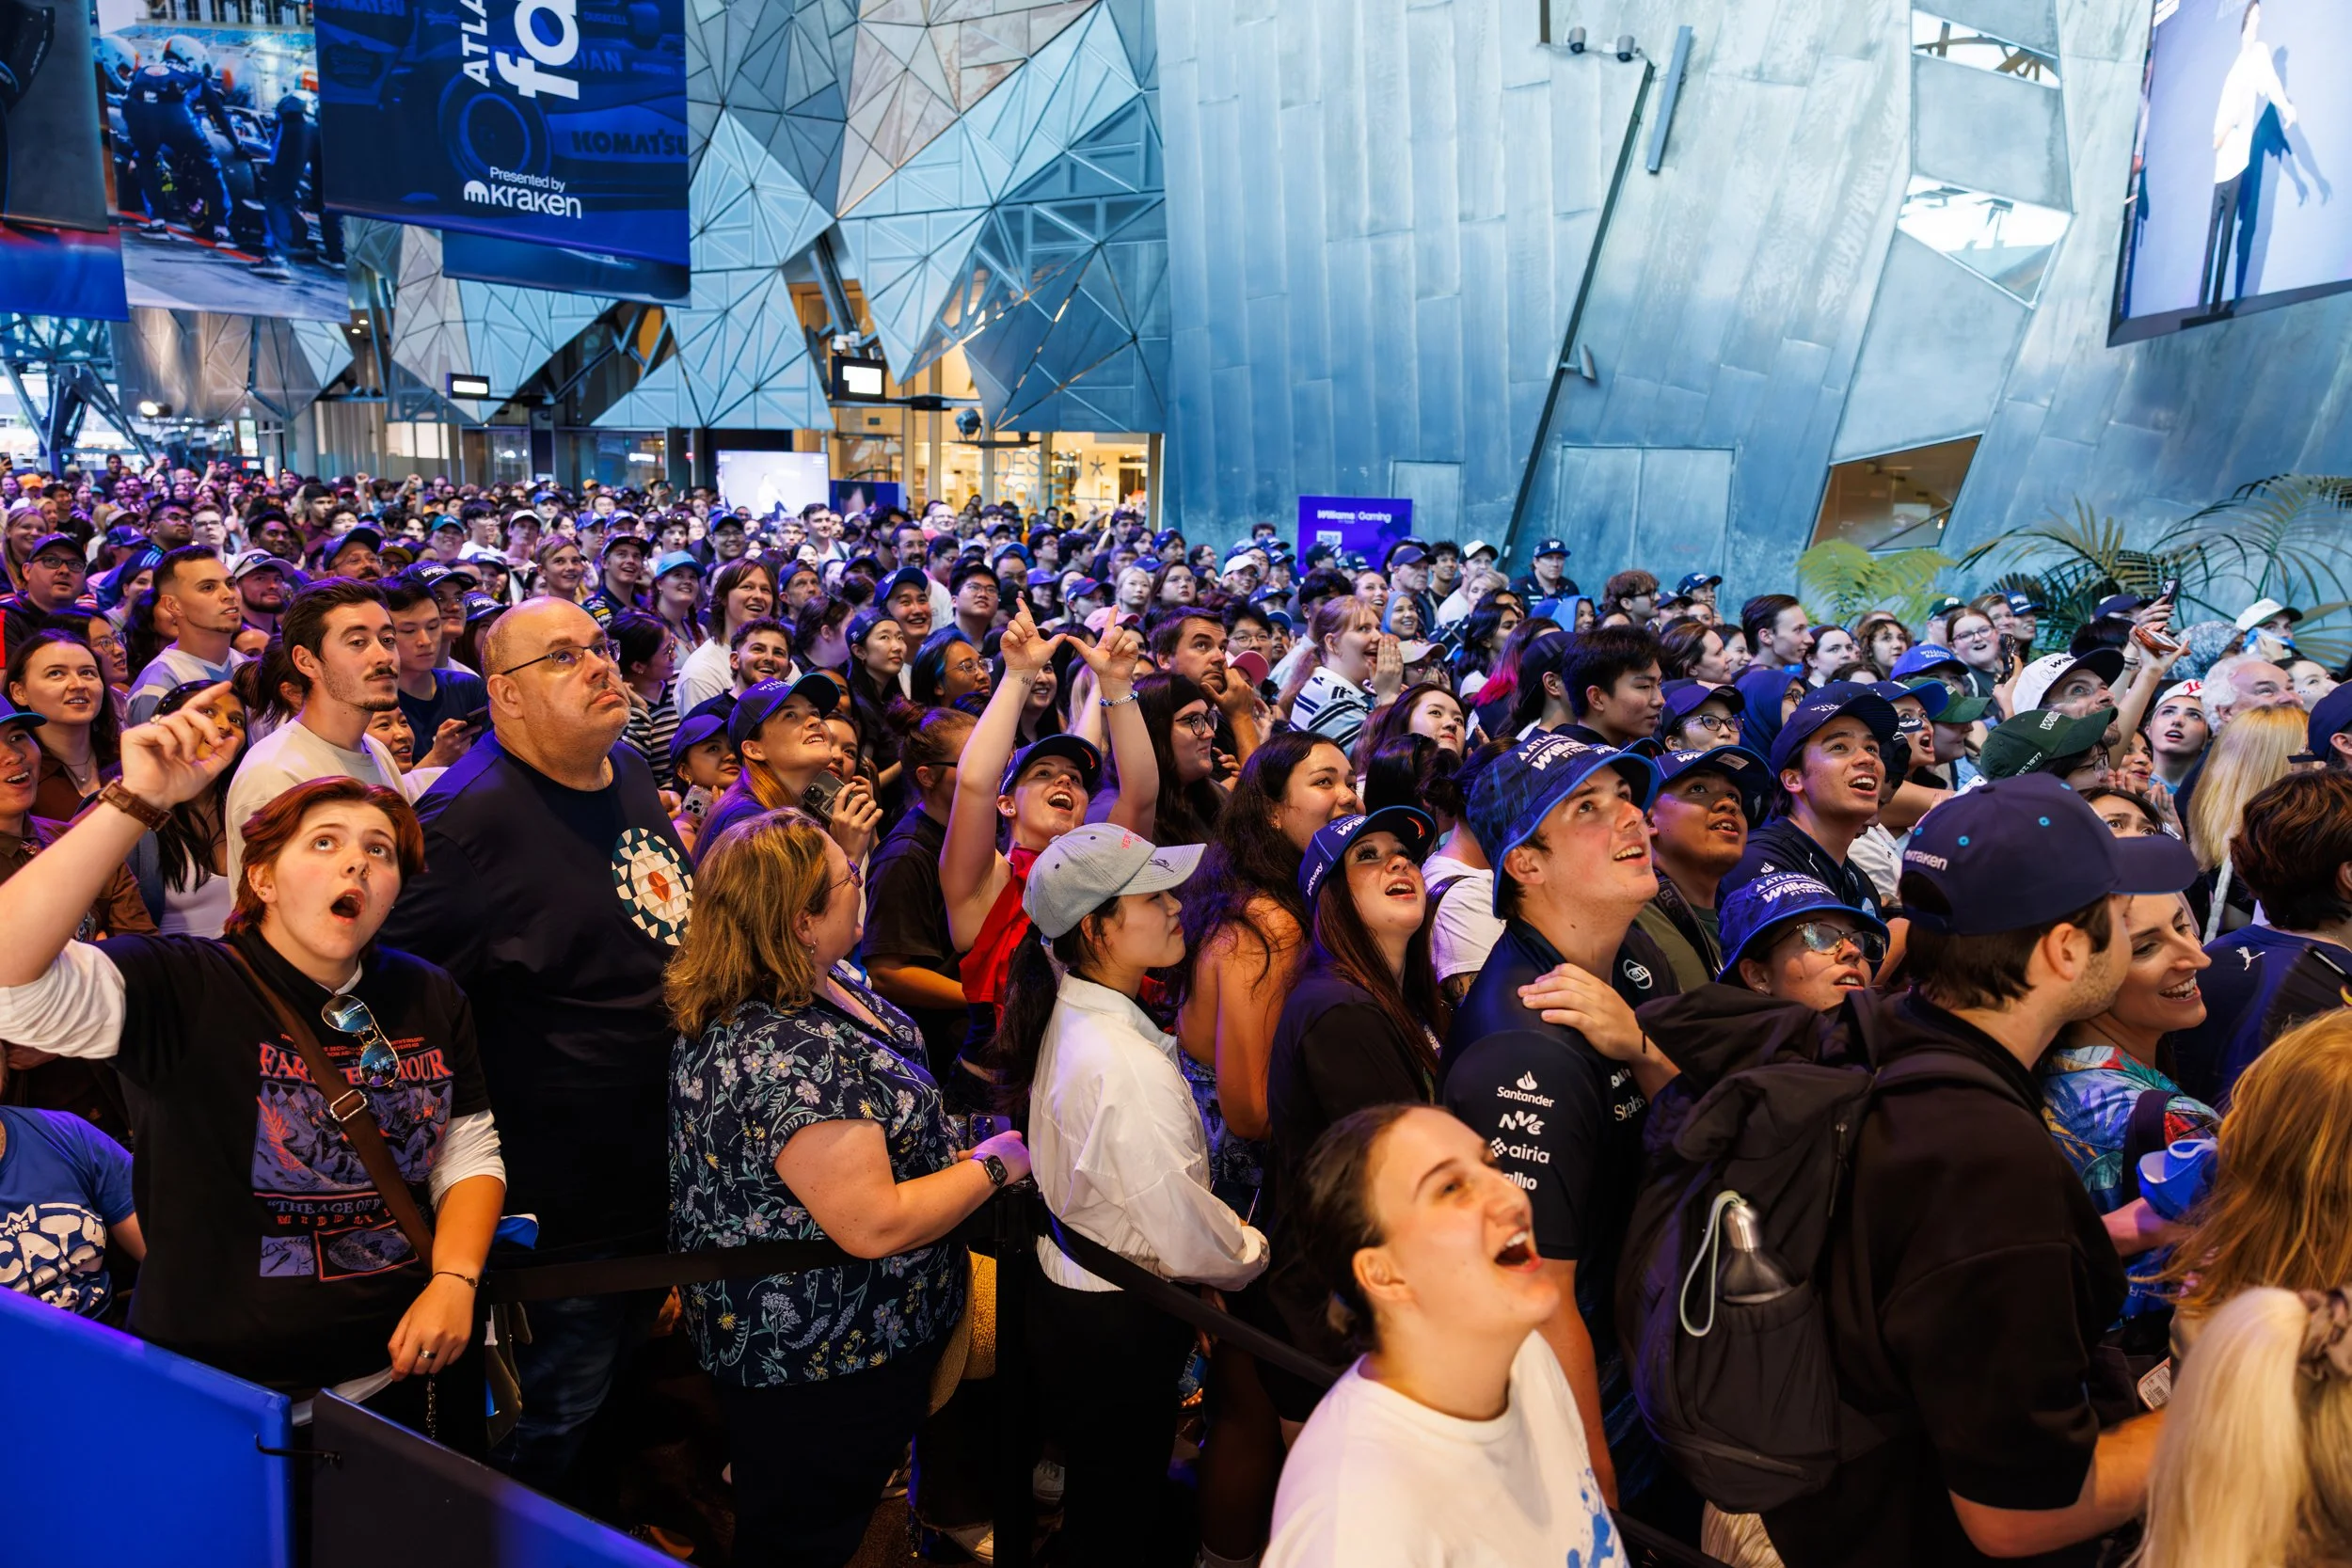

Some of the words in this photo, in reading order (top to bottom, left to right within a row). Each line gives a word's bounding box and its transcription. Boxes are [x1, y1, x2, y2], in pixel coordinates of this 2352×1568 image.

[489, 166, 550, 189] Presented
[550, 176, 566, 194] by
[490, 183, 582, 219] kraken
[996, 450, 1082, 479] DESGN
[1358, 511, 1392, 524] Gaming
[1497, 1085, 1554, 1108] Santander
[1508, 1143, 1550, 1164] airia
[317, 1199, 354, 1213] AGE
[356, 1199, 370, 1212] OF
